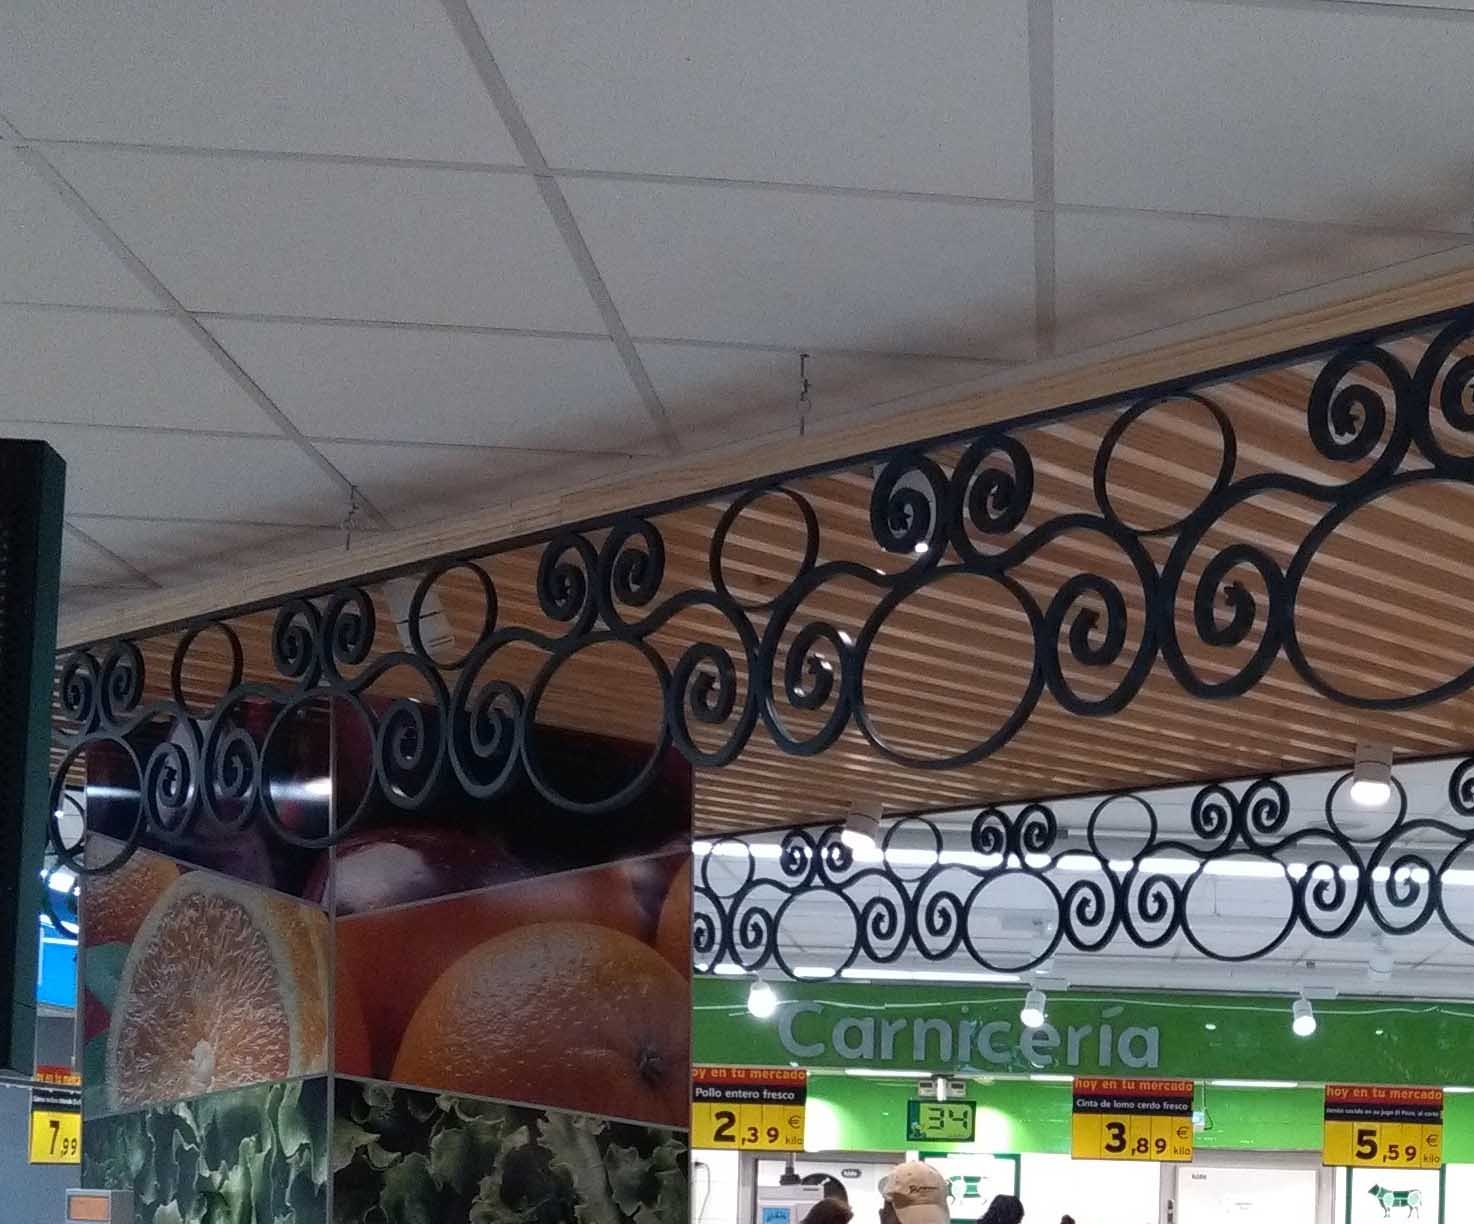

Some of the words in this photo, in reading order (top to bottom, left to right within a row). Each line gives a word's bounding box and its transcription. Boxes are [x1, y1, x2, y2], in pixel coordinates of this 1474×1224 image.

[777, 1003, 1159, 1068] Carnicería
[711, 1069, 727, 1078] en
[732, 1068, 745, 1078] tu
[749, 1069, 806, 1080] mercado
[1075, 1079, 1097, 1092] hoy
[1102, 1081, 1117, 1089] en
[1122, 1080, 1136, 1090] tu
[1139, 1081, 1193, 1092] mercado
[695, 1087, 722, 1098] Pollo
[725, 1089, 760, 1099] entero
[762, 1089, 795, 1100] fresco
[1326, 1086, 1348, 1100] hoy
[1353, 1087, 1368, 1097] en
[1373, 1087, 1385, 1098] tu
[1389, 1088, 1442, 1100] mercado
[1076, 1099, 1098, 1108] Cinta
[1100, 1099, 1111, 1108] de
[1113, 1100, 1135, 1109] lomo
[1162, 1101, 1189, 1111] fresco
[927, 1107, 969, 1130] 34
[1173, 1146, 1191, 1156] kilo
[1423, 1154, 1440, 1163] kilo
